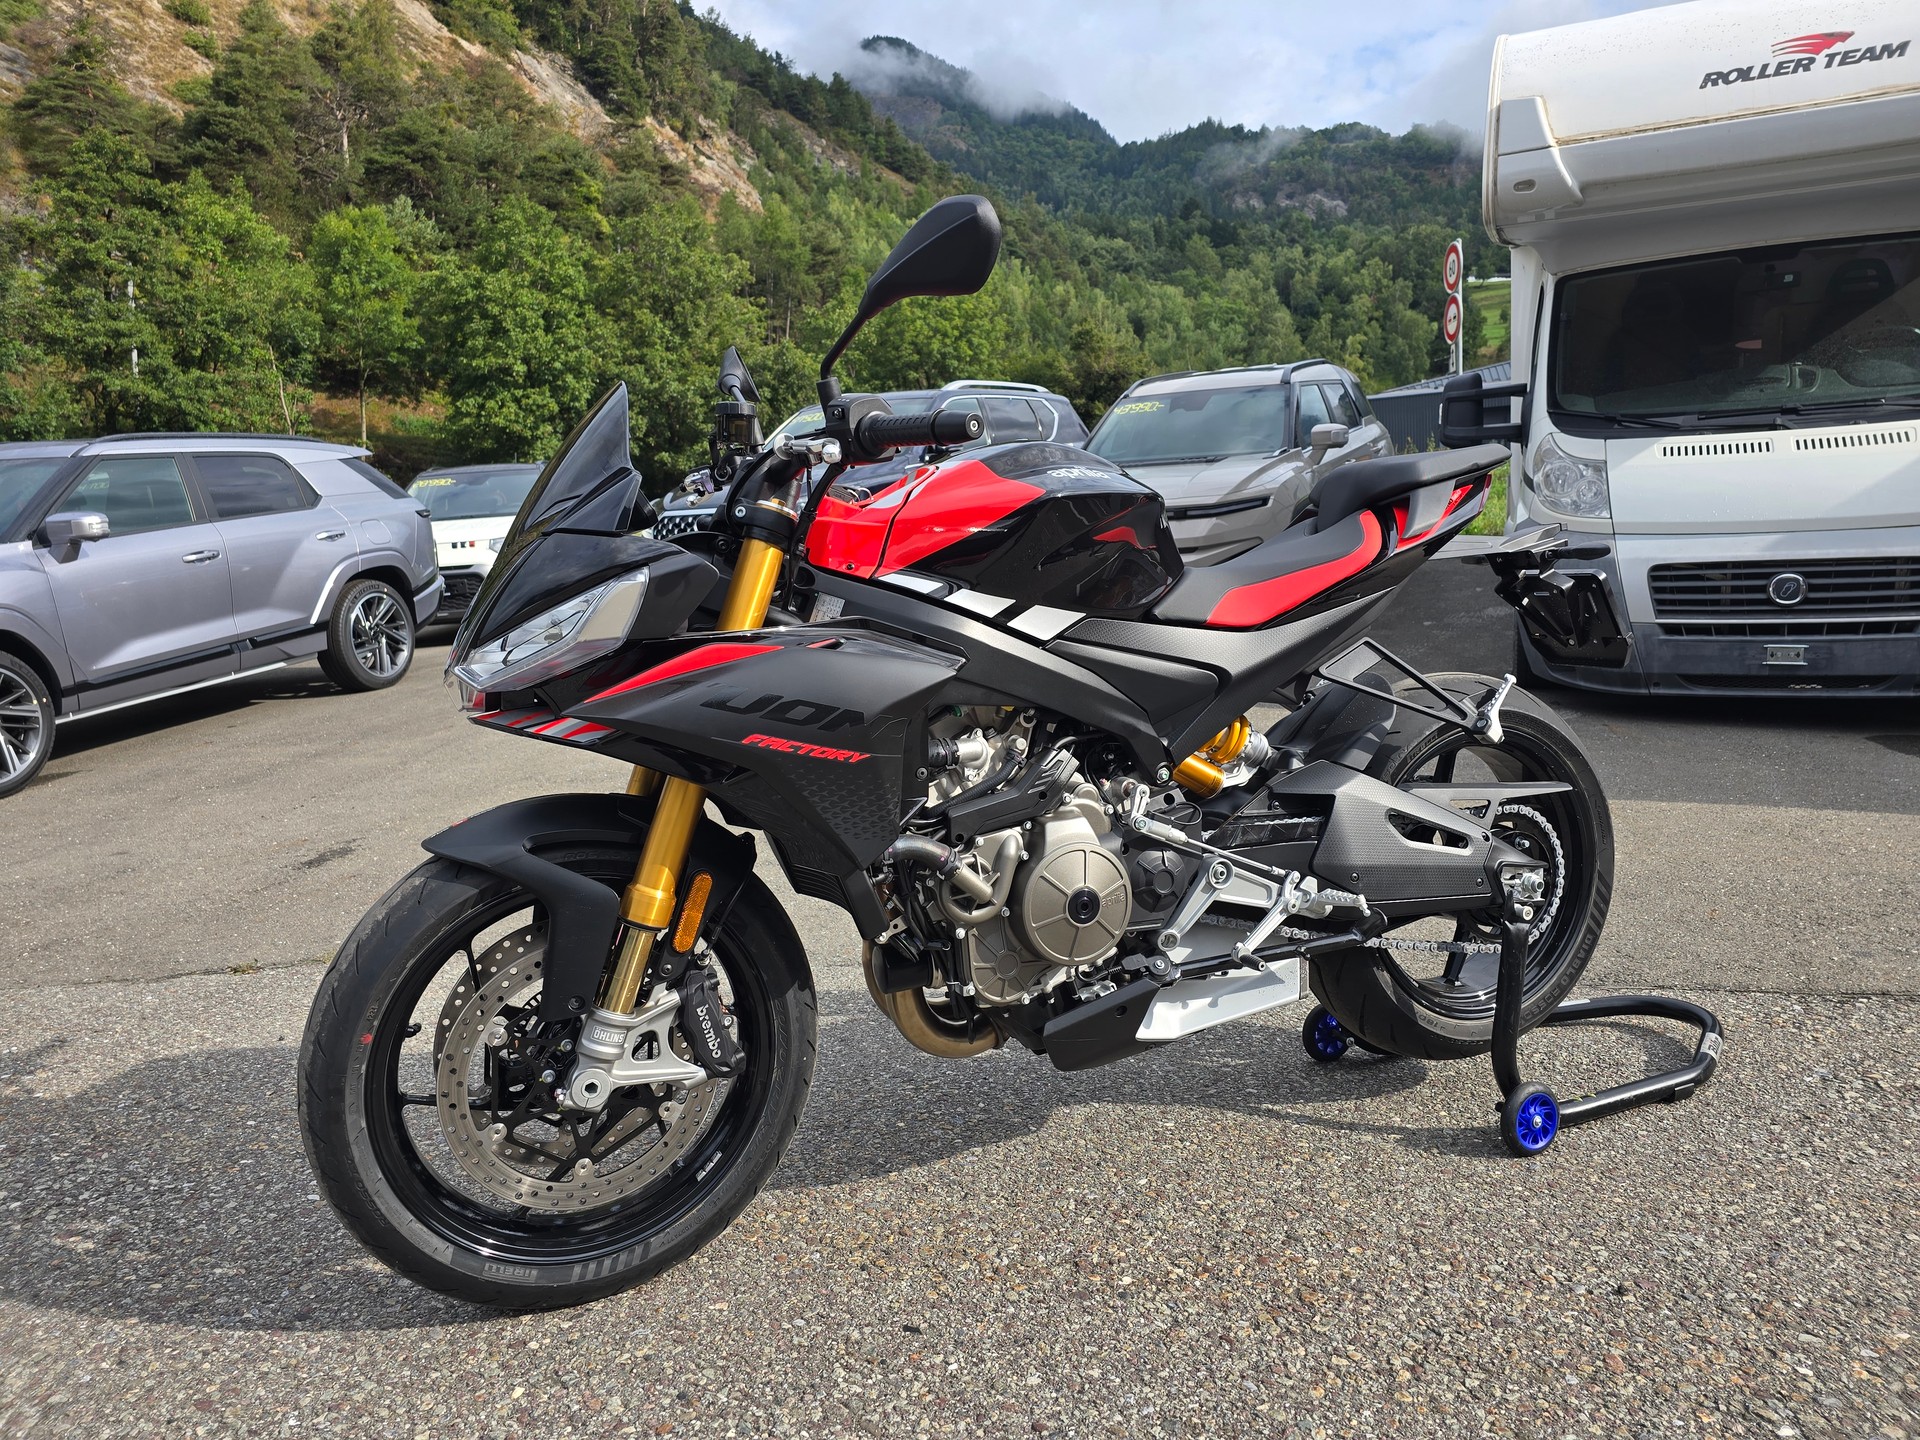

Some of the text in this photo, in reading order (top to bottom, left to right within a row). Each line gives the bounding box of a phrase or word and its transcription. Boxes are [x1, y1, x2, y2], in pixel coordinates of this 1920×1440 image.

[1699, 40, 1911, 89] ROLLER TEAM
[1448, 259, 1456, 278] 60
[1047, 466, 1111, 480] aprilia
[741, 733, 871, 763] FACTORY
[594, 1027, 624, 1043] ÖHLINS
[696, 1004, 721, 1058] brembo
